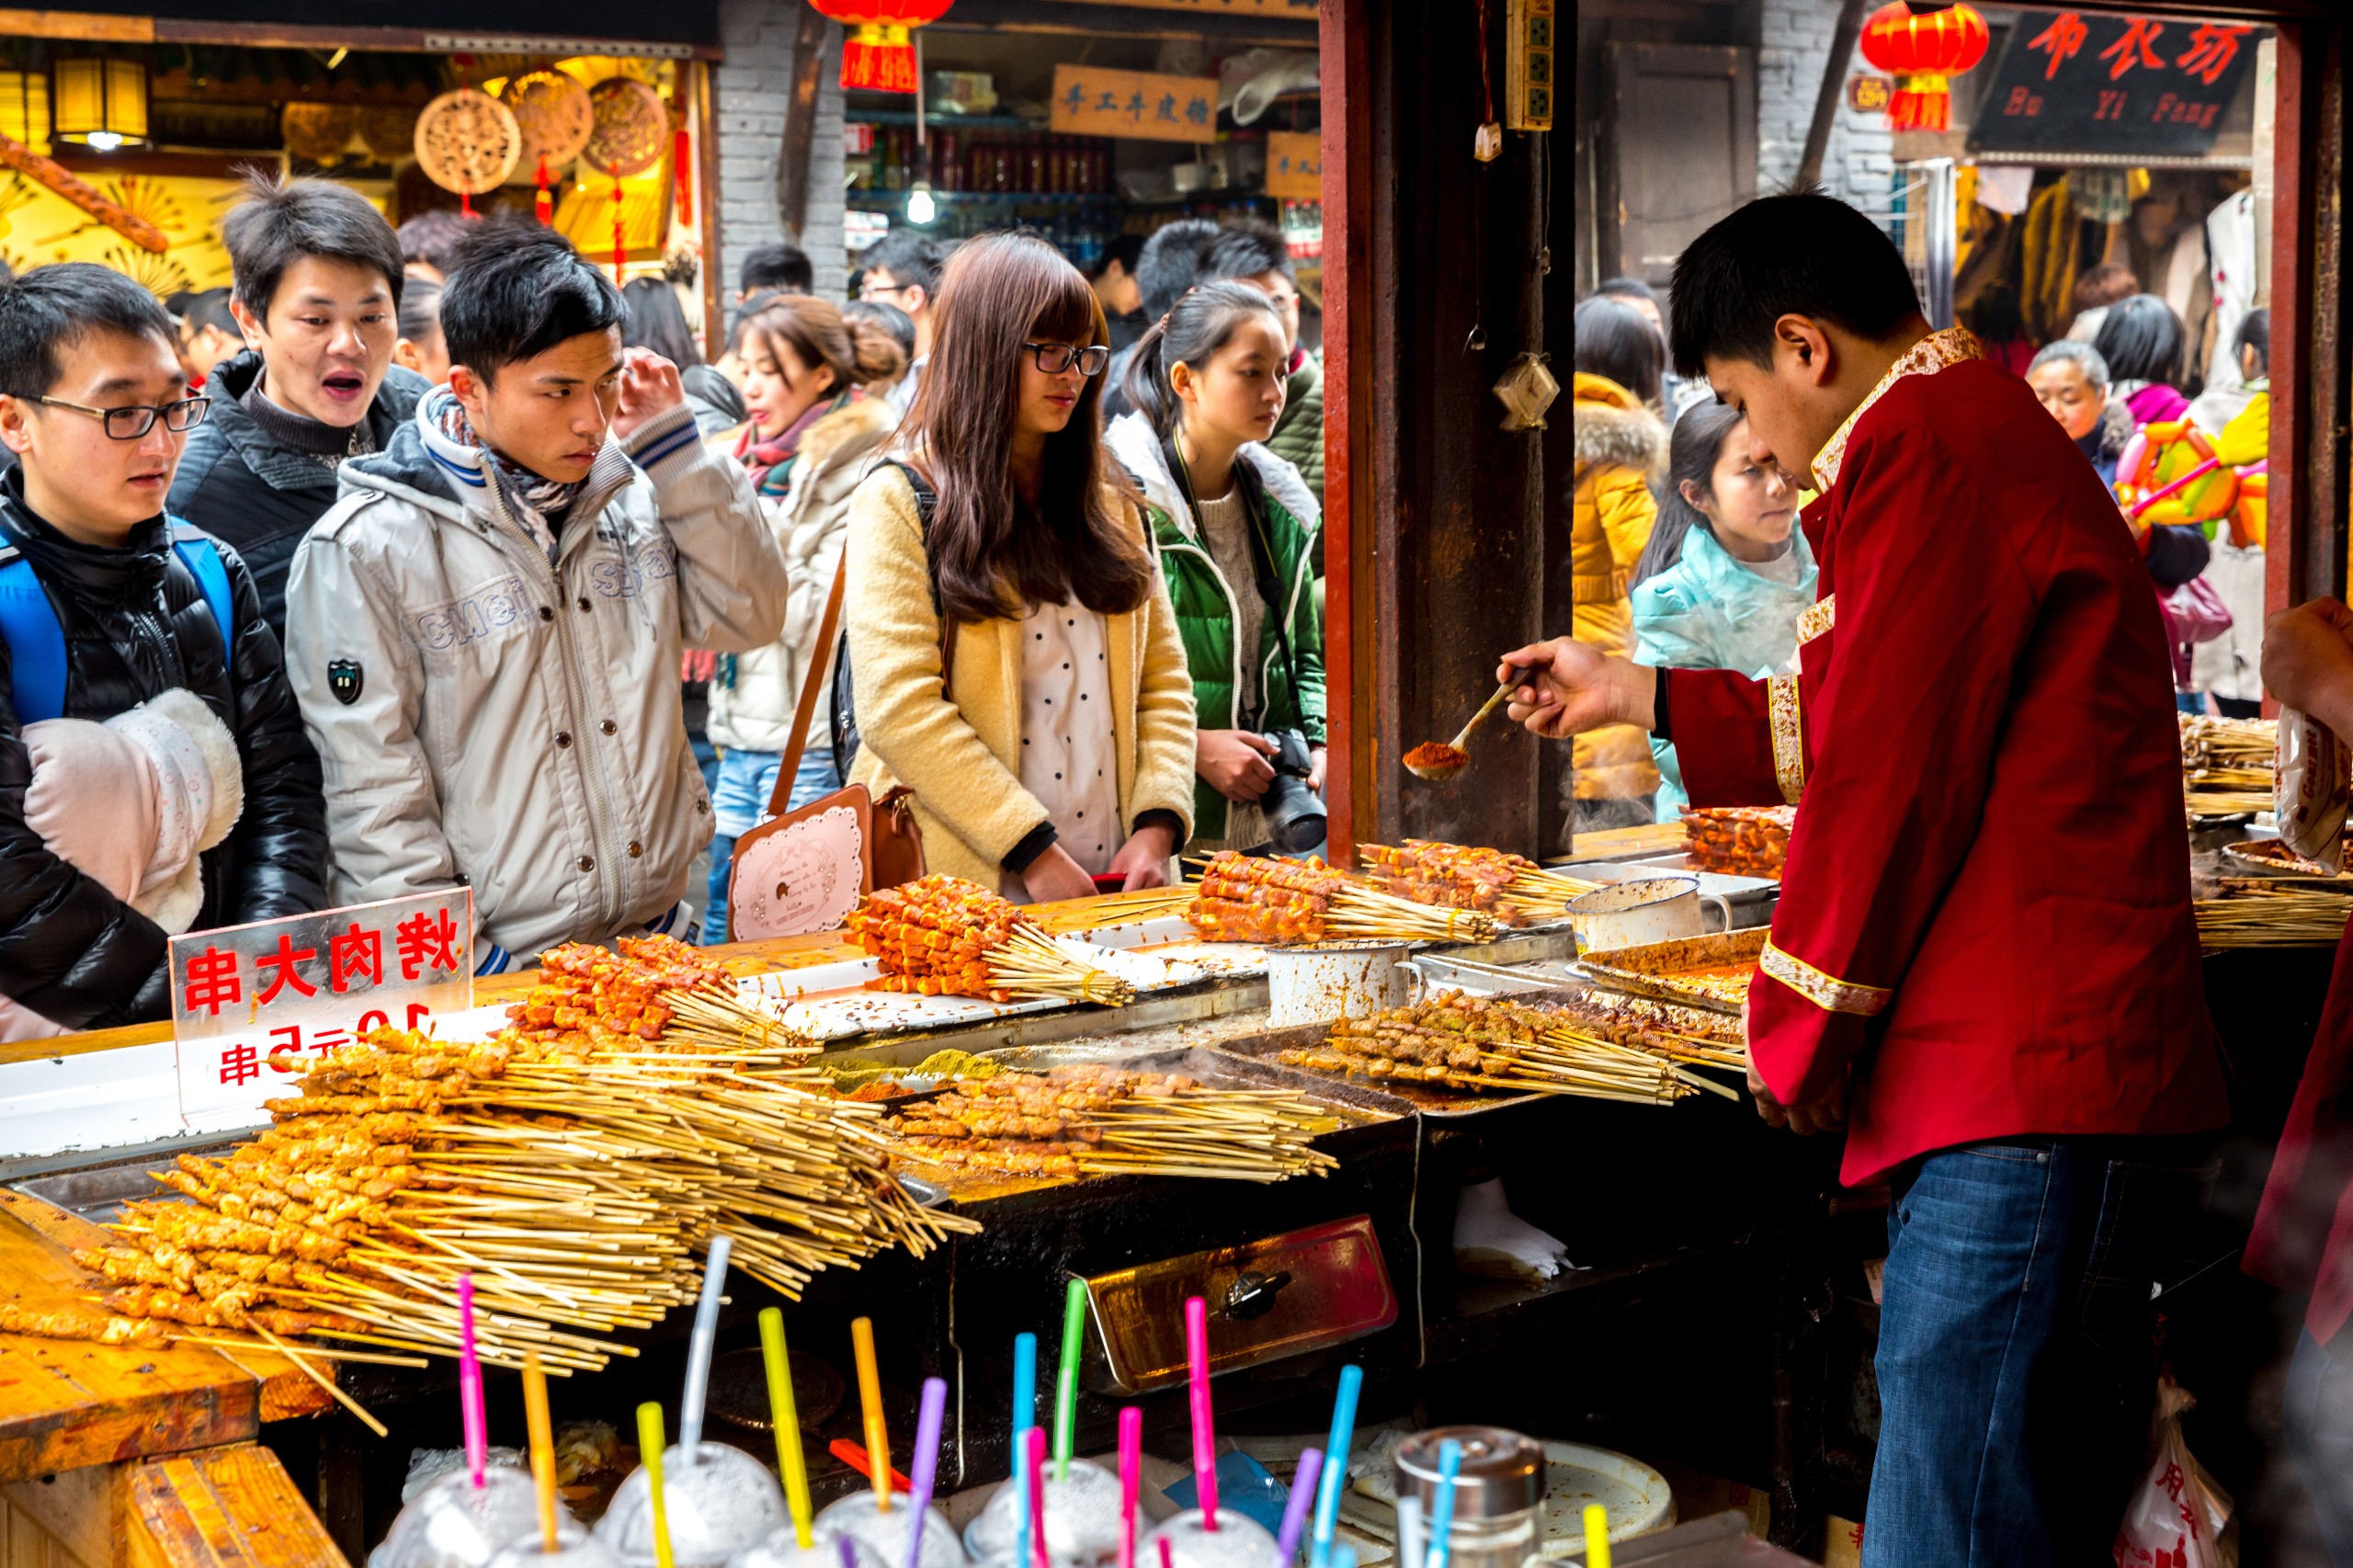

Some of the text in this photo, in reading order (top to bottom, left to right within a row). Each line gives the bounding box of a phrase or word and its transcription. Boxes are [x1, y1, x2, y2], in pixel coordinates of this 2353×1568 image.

[2026, 11, 2255, 86] 布衣坊
[2003, 85, 2045, 118] Bu
[2092, 89, 2129, 121] Yi
